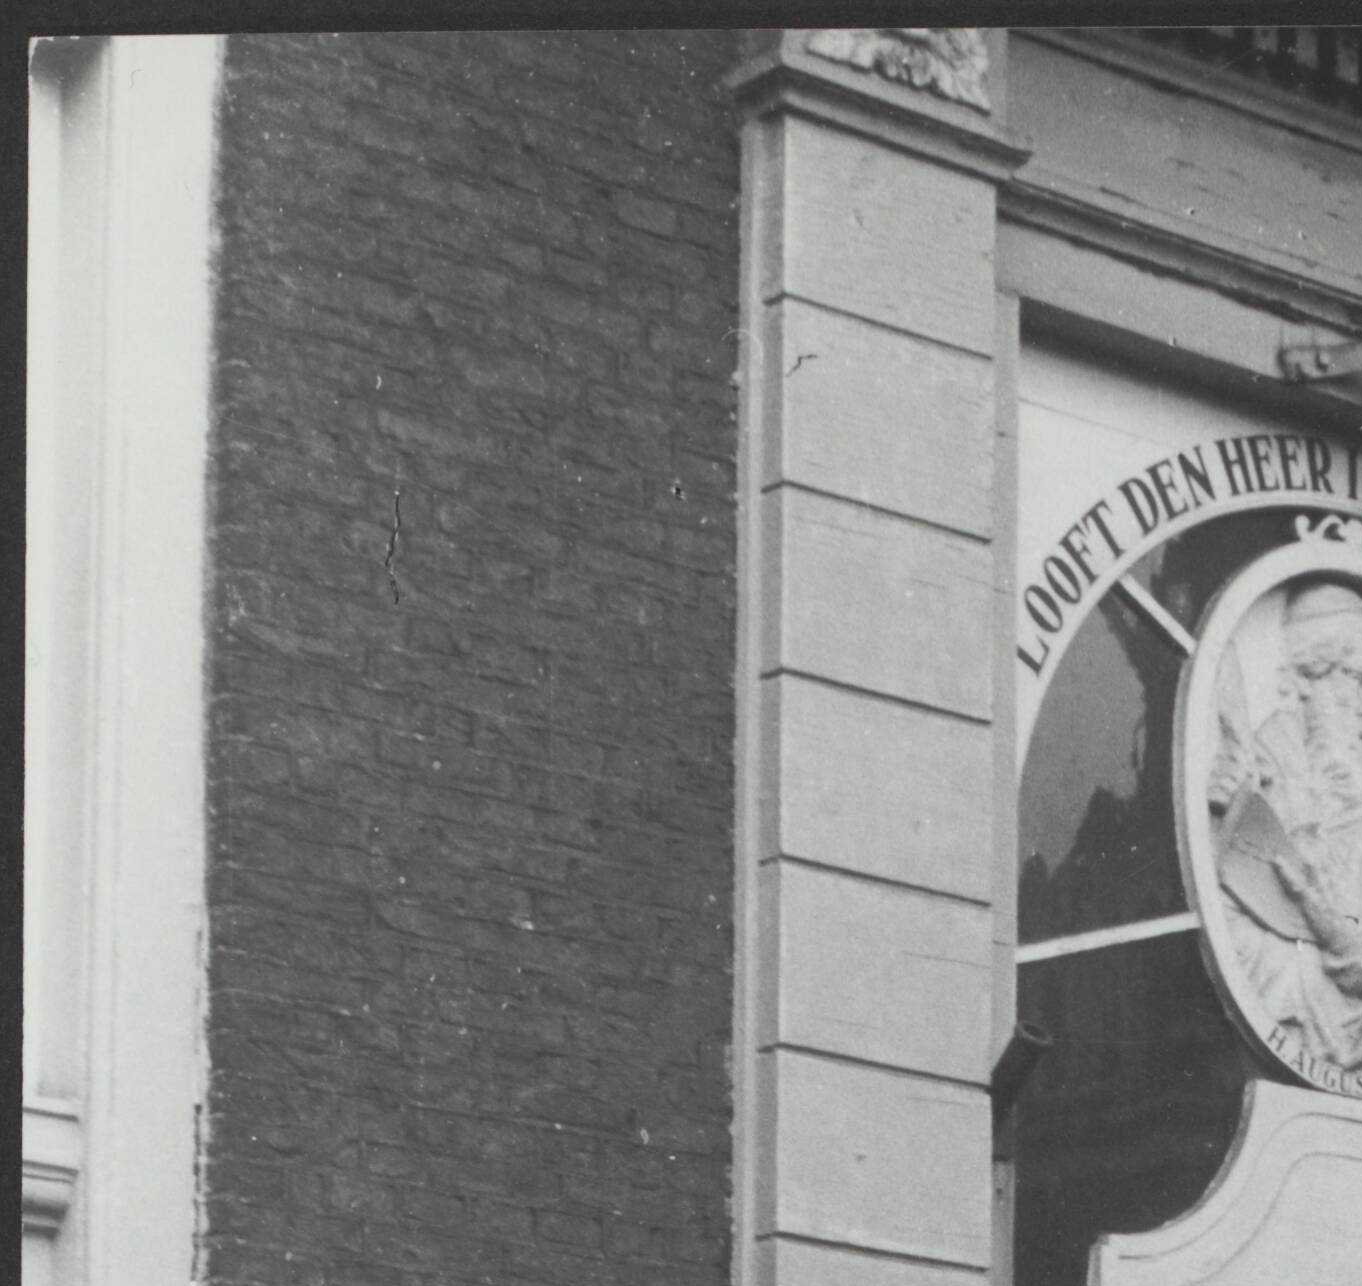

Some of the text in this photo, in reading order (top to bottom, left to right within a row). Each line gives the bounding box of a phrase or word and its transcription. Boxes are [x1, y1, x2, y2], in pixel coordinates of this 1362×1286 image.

[1017, 499, 1126, 677] LOOFT
[1117, 445, 1217, 536] DEN
[1215, 434, 1335, 497] HEER
